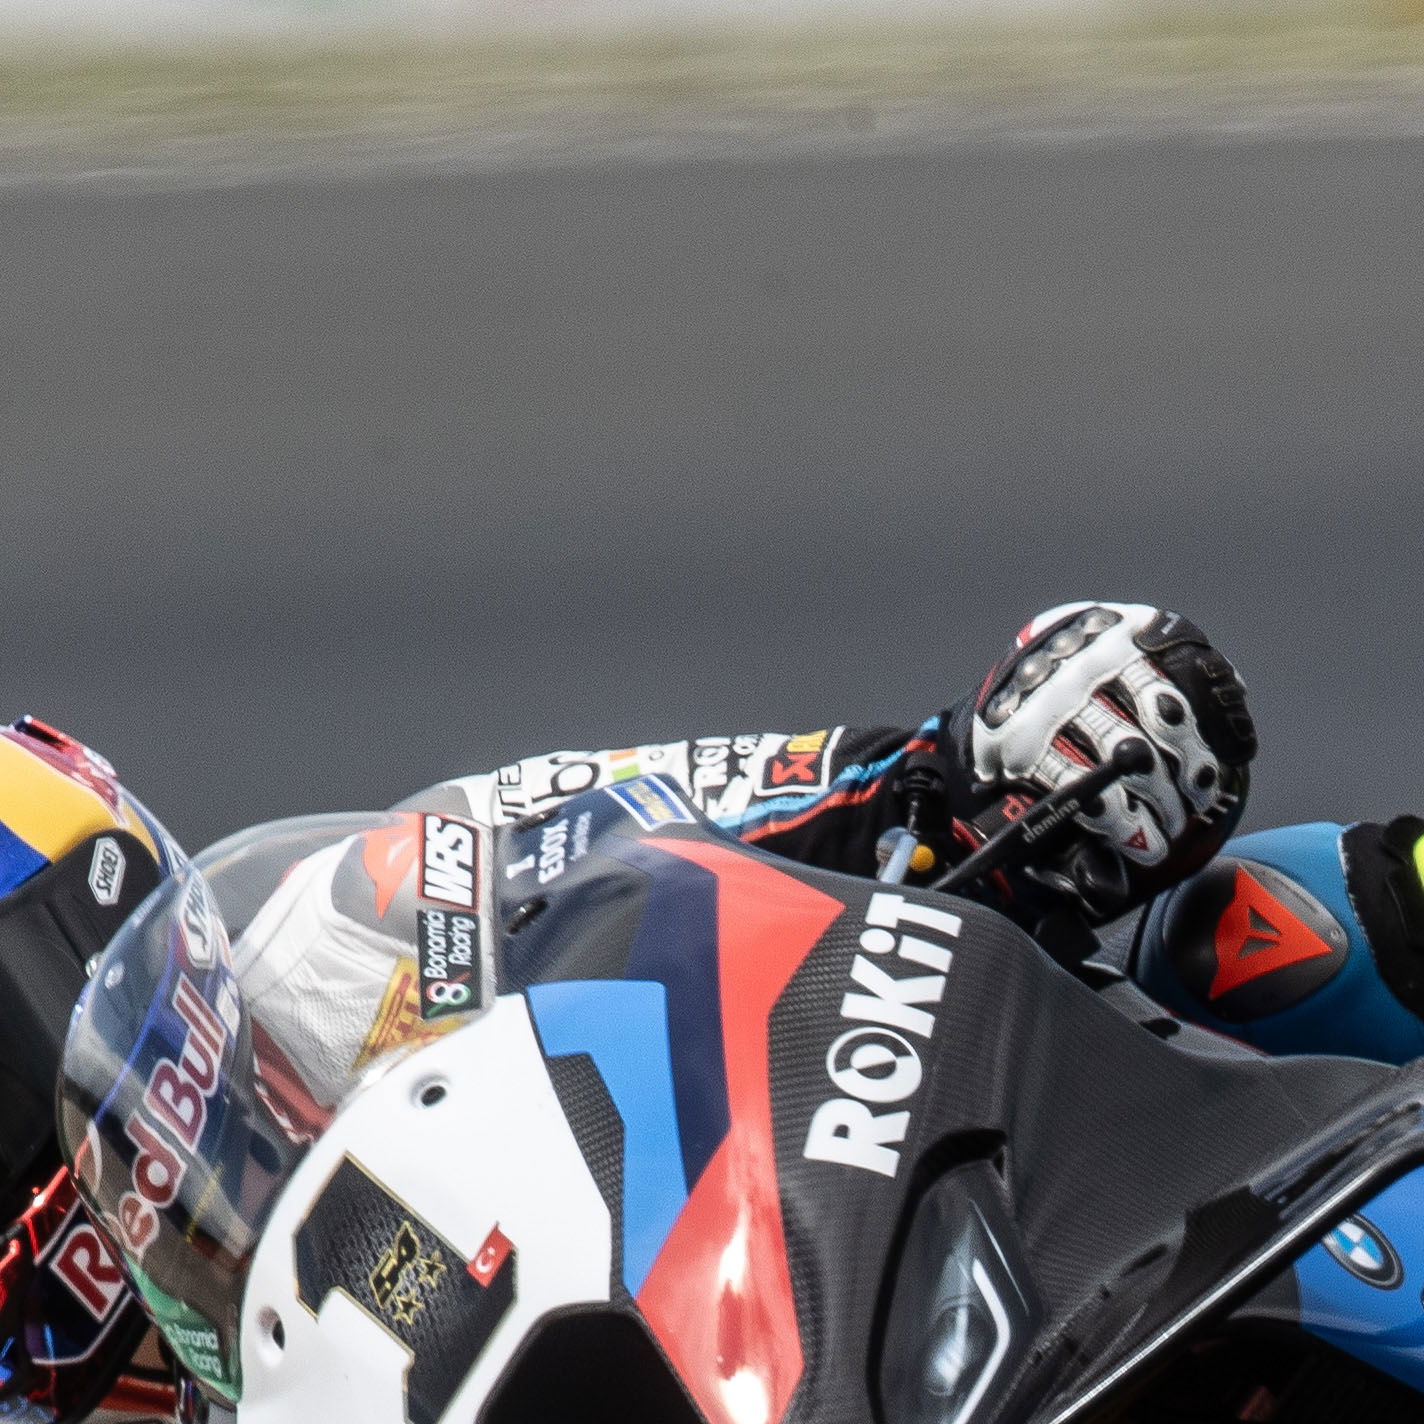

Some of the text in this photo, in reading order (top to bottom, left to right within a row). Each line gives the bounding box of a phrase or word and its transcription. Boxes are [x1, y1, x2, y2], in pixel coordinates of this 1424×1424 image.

[1021, 798, 1082, 845] domino
[95, 848, 118, 896] SHOEI
[424, 815, 474, 907] WRS
[538, 819, 570, 884] EDOX
[448, 916, 476, 967] Racing
